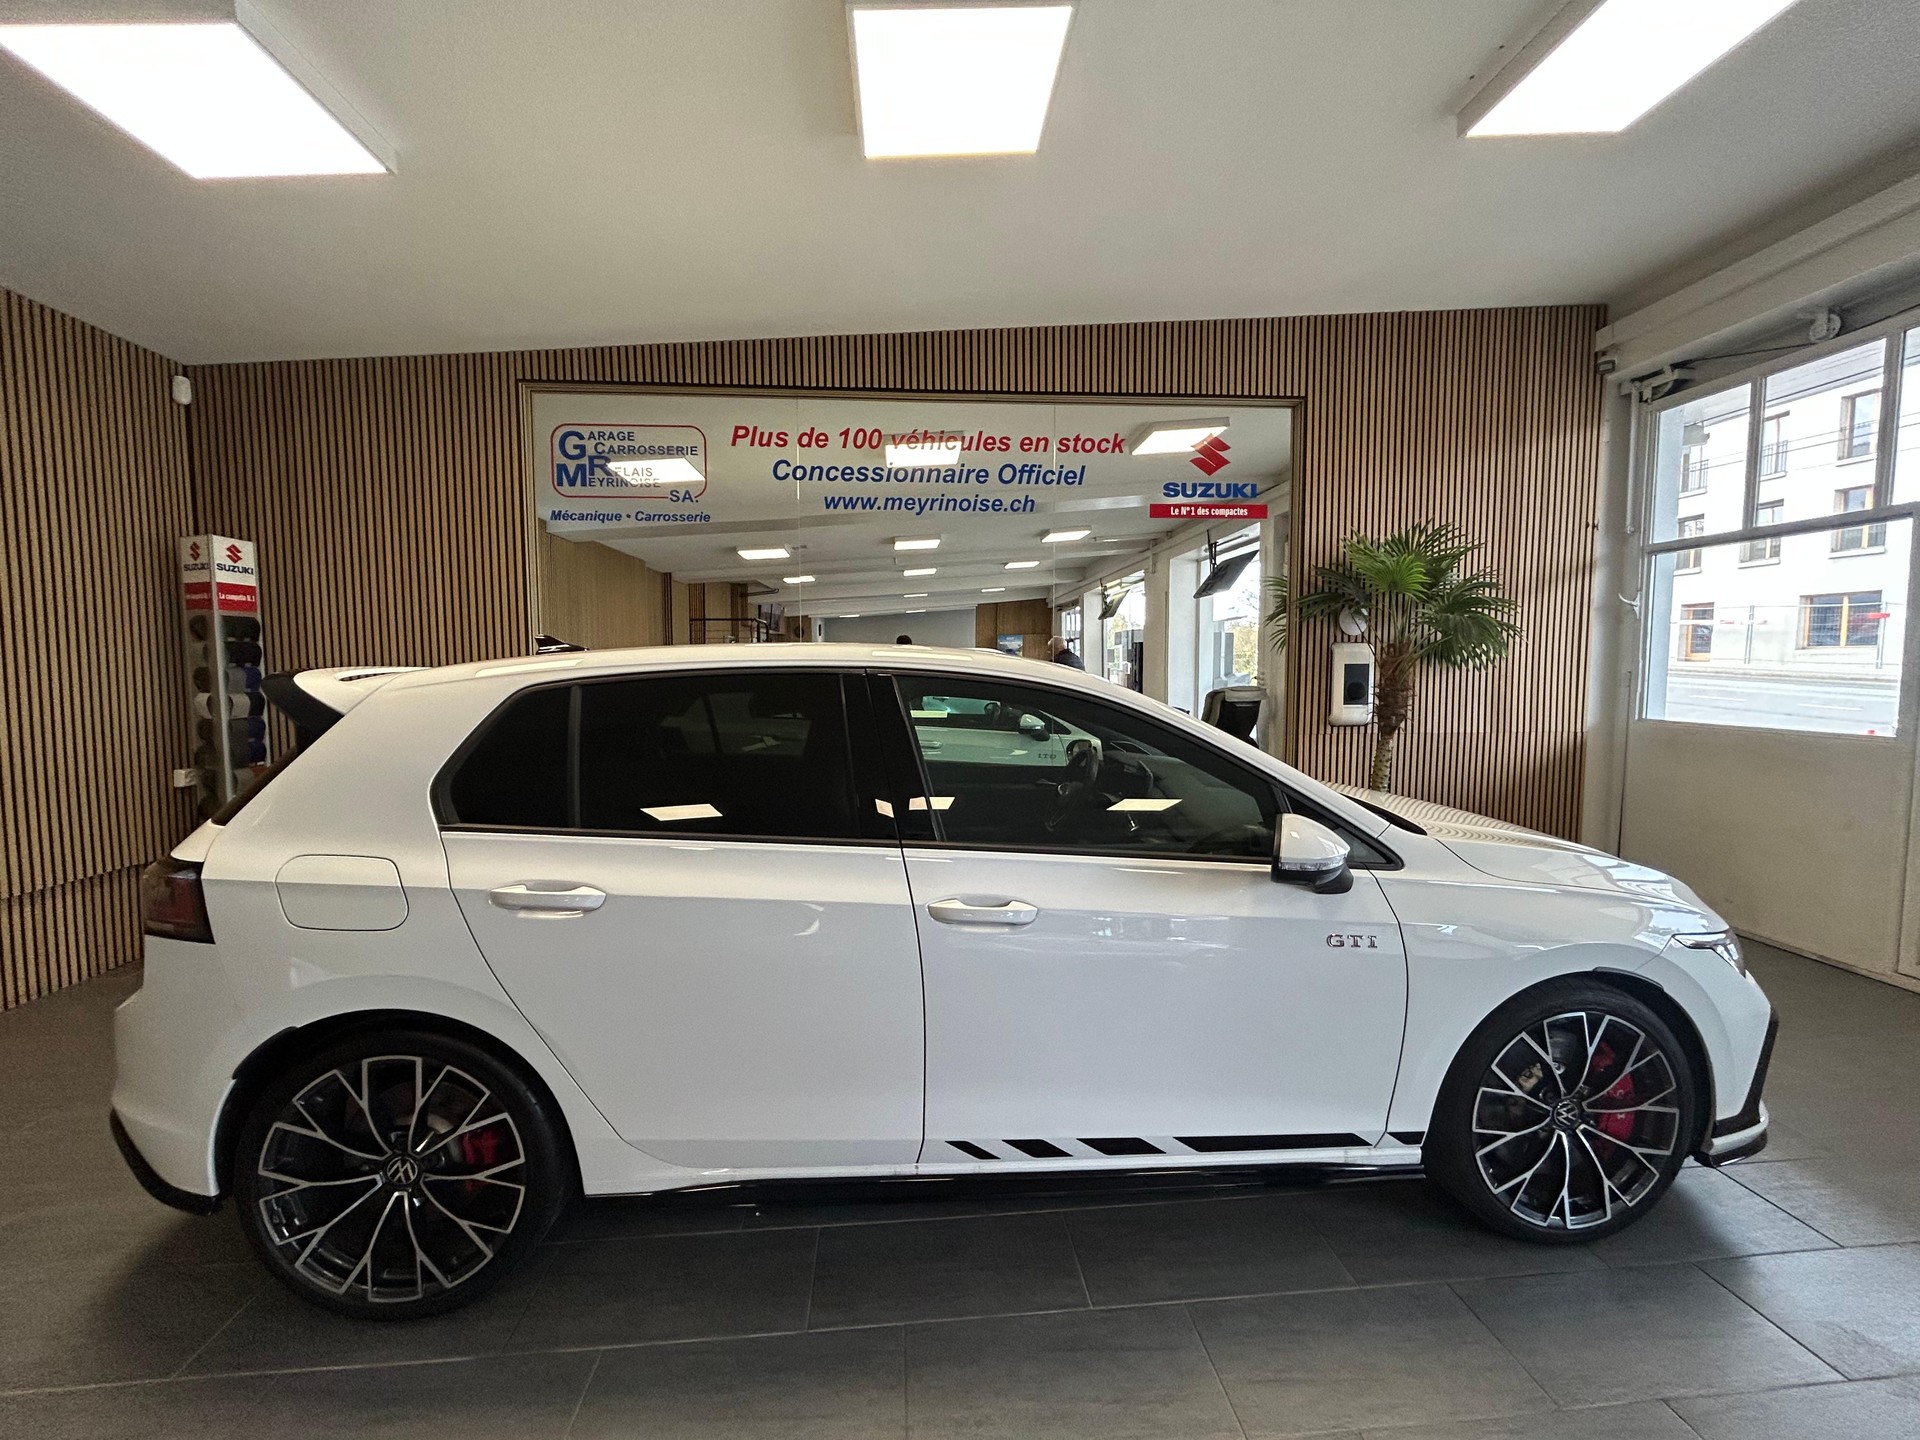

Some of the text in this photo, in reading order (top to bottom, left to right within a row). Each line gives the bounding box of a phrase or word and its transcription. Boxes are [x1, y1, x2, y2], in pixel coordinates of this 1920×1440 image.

[558, 430, 635, 461] GARAGE
[731, 425, 1126, 453] Plus de 100 véhicules en stock
[593, 442, 698, 456] CARROSSERIE
[772, 459, 1086, 485] Concessionnaire Officiel
[669, 489, 699, 503] SA.
[1163, 482, 1257, 498] SUZUKI
[824, 494, 1035, 516] www.meyrinoise.ch
[1170, 506, 1180, 515] Le
[1196, 506, 1210, 515] des
[1210, 507, 1248, 517] compactes
[550, 510, 711, 523] Mécanique Carrosserie
[216, 562, 254, 575] SUZUKI
[1326, 934, 1378, 949] GTI
